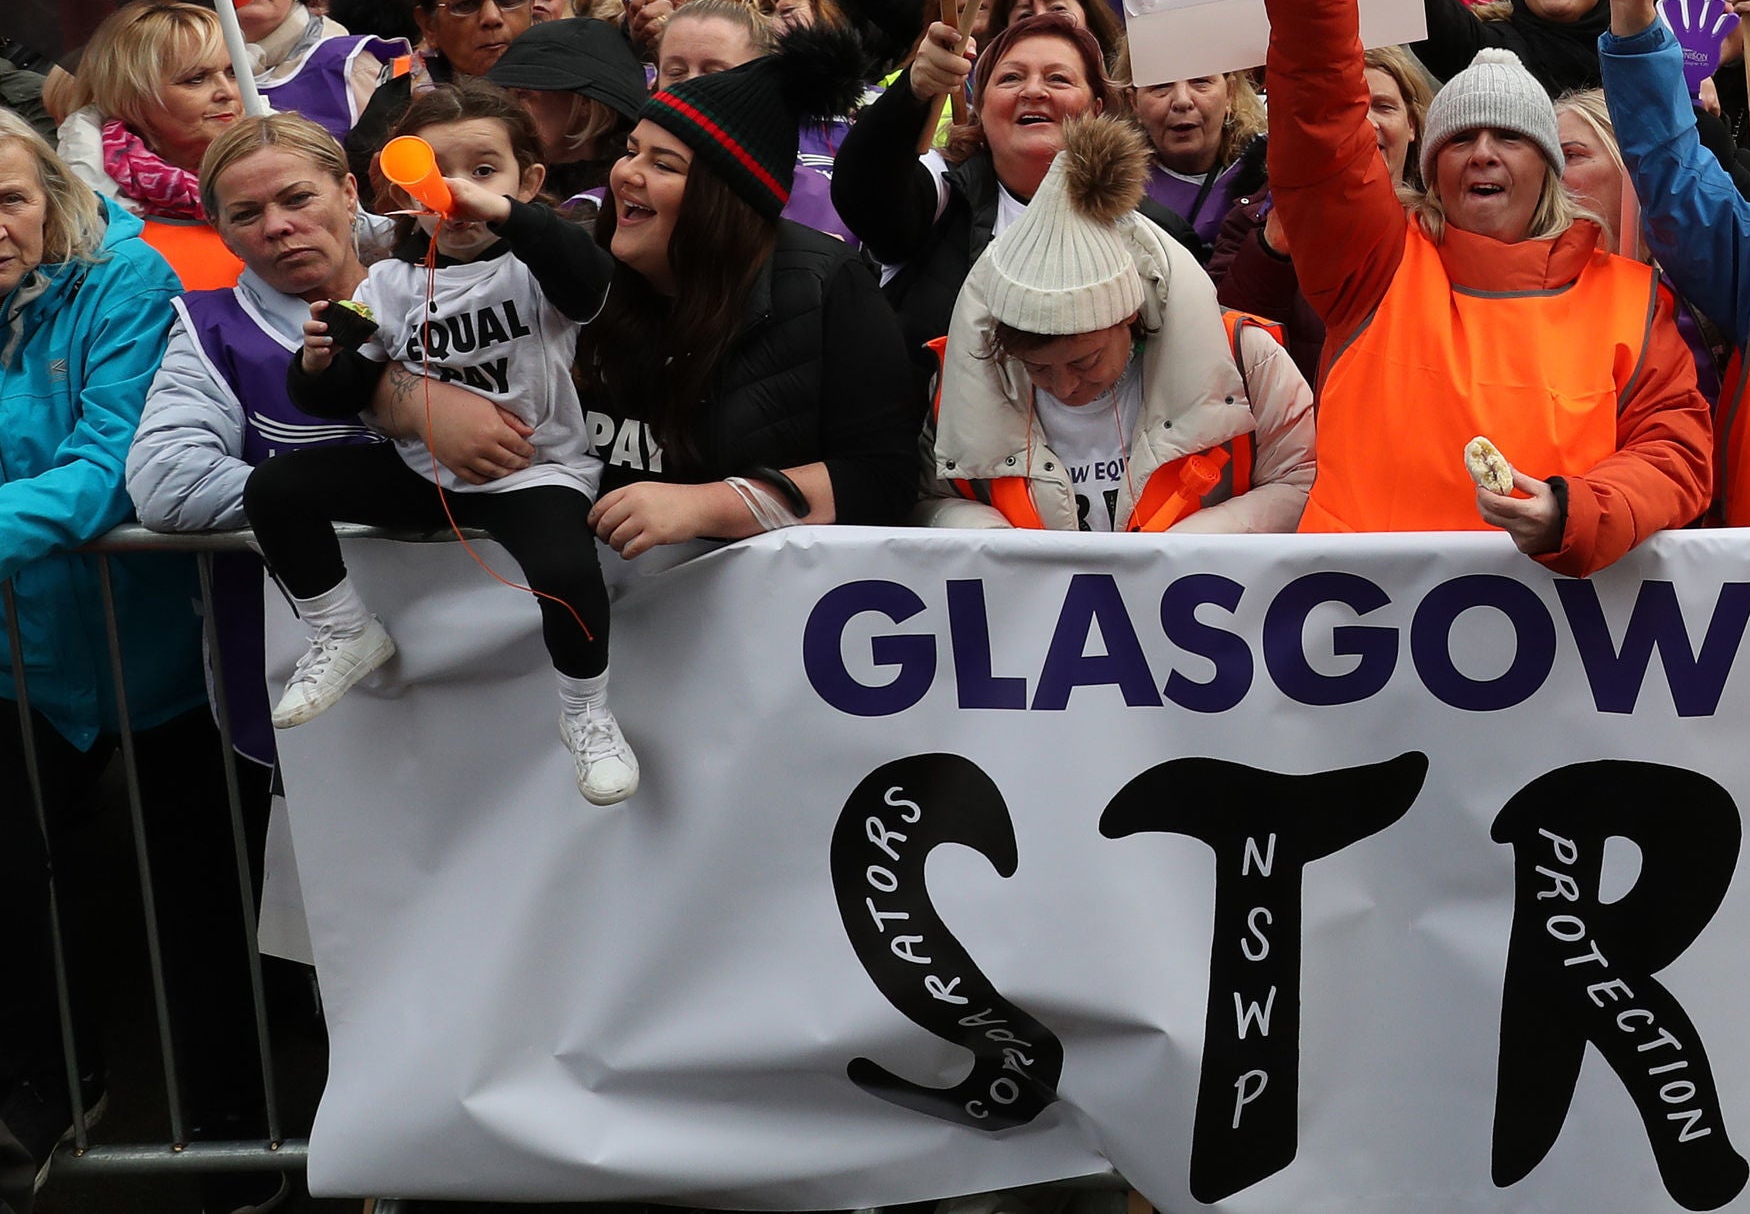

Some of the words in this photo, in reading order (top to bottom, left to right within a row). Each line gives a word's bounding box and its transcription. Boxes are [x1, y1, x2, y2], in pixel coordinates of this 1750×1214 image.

[407, 300, 530, 361] EQUAL
[586, 411, 663, 473] PAY
[1233, 832, 1276, 1129] NSWP
[1535, 827, 1711, 1143] PROTECTION
